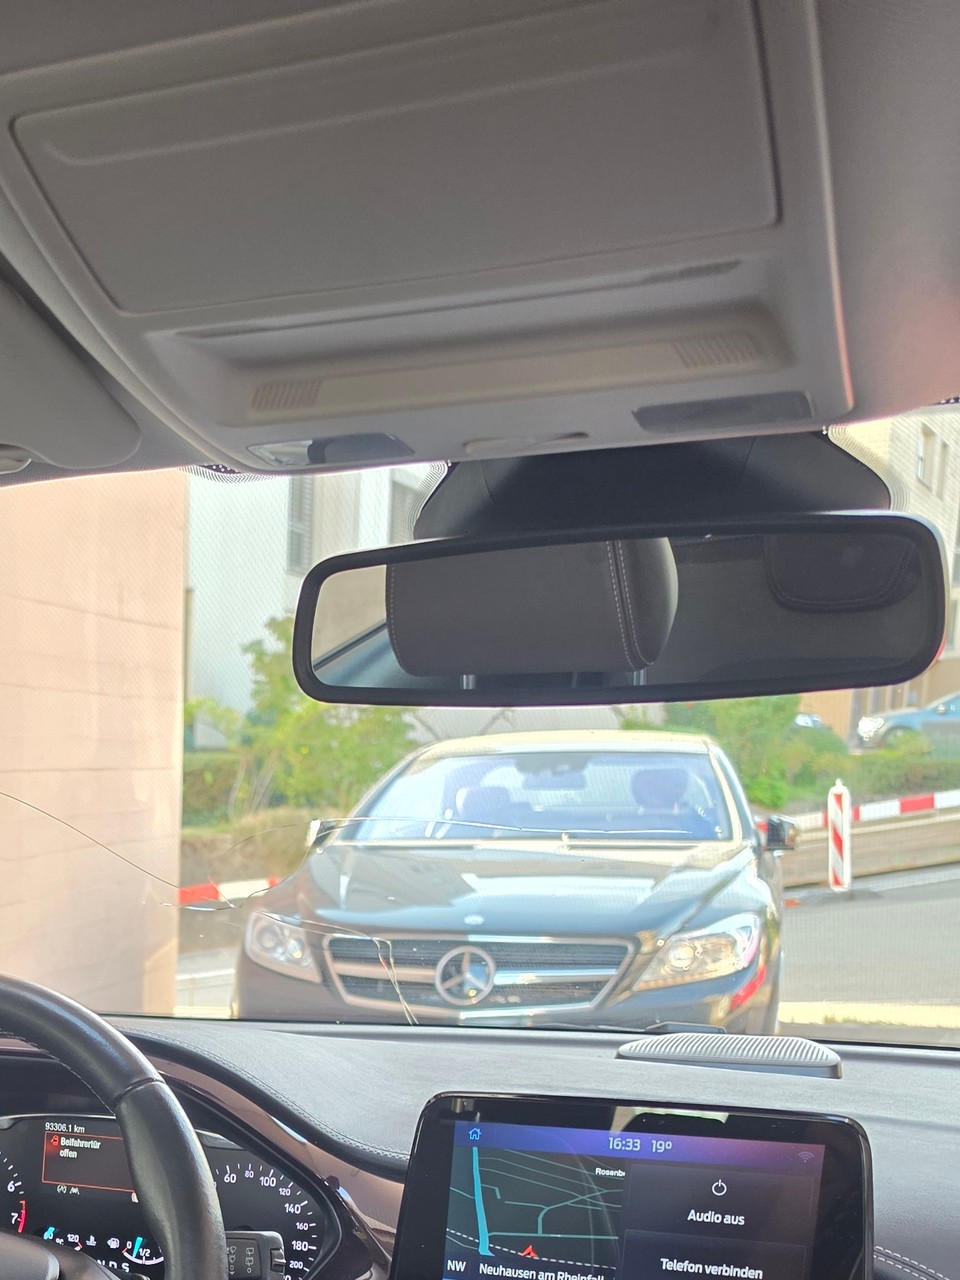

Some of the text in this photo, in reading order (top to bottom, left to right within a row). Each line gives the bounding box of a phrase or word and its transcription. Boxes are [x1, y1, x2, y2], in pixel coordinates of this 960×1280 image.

[45, 1122, 85, 1133] 93306.1 km
[60, 1137, 101, 1149] Beifahrertür
[608, 1137, 641, 1151] 16:33
[59, 1149, 78, 1158] offen
[224, 1173, 237, 1184] 60
[244, 1170, 254, 1178] 80
[7, 1181, 15, 1192] 6
[259, 1176, 276, 1187] 100
[278, 1187, 291, 1196] 120
[284, 1203, 301, 1214] 140
[10, 1212, 18, 1223] 7
[687, 1209, 745, 1225] Audio aus
[295, 1222, 308, 1230] 160
[67, 1233, 80, 1243] 120
[291, 1240, 308, 1251] 180
[289, 1261, 304, 1269] 200
[447, 1259, 466, 1272] NW
[660, 1257, 763, 1280] Telefon verbinden
[479, 1263, 536, 1280] Neuhausen
